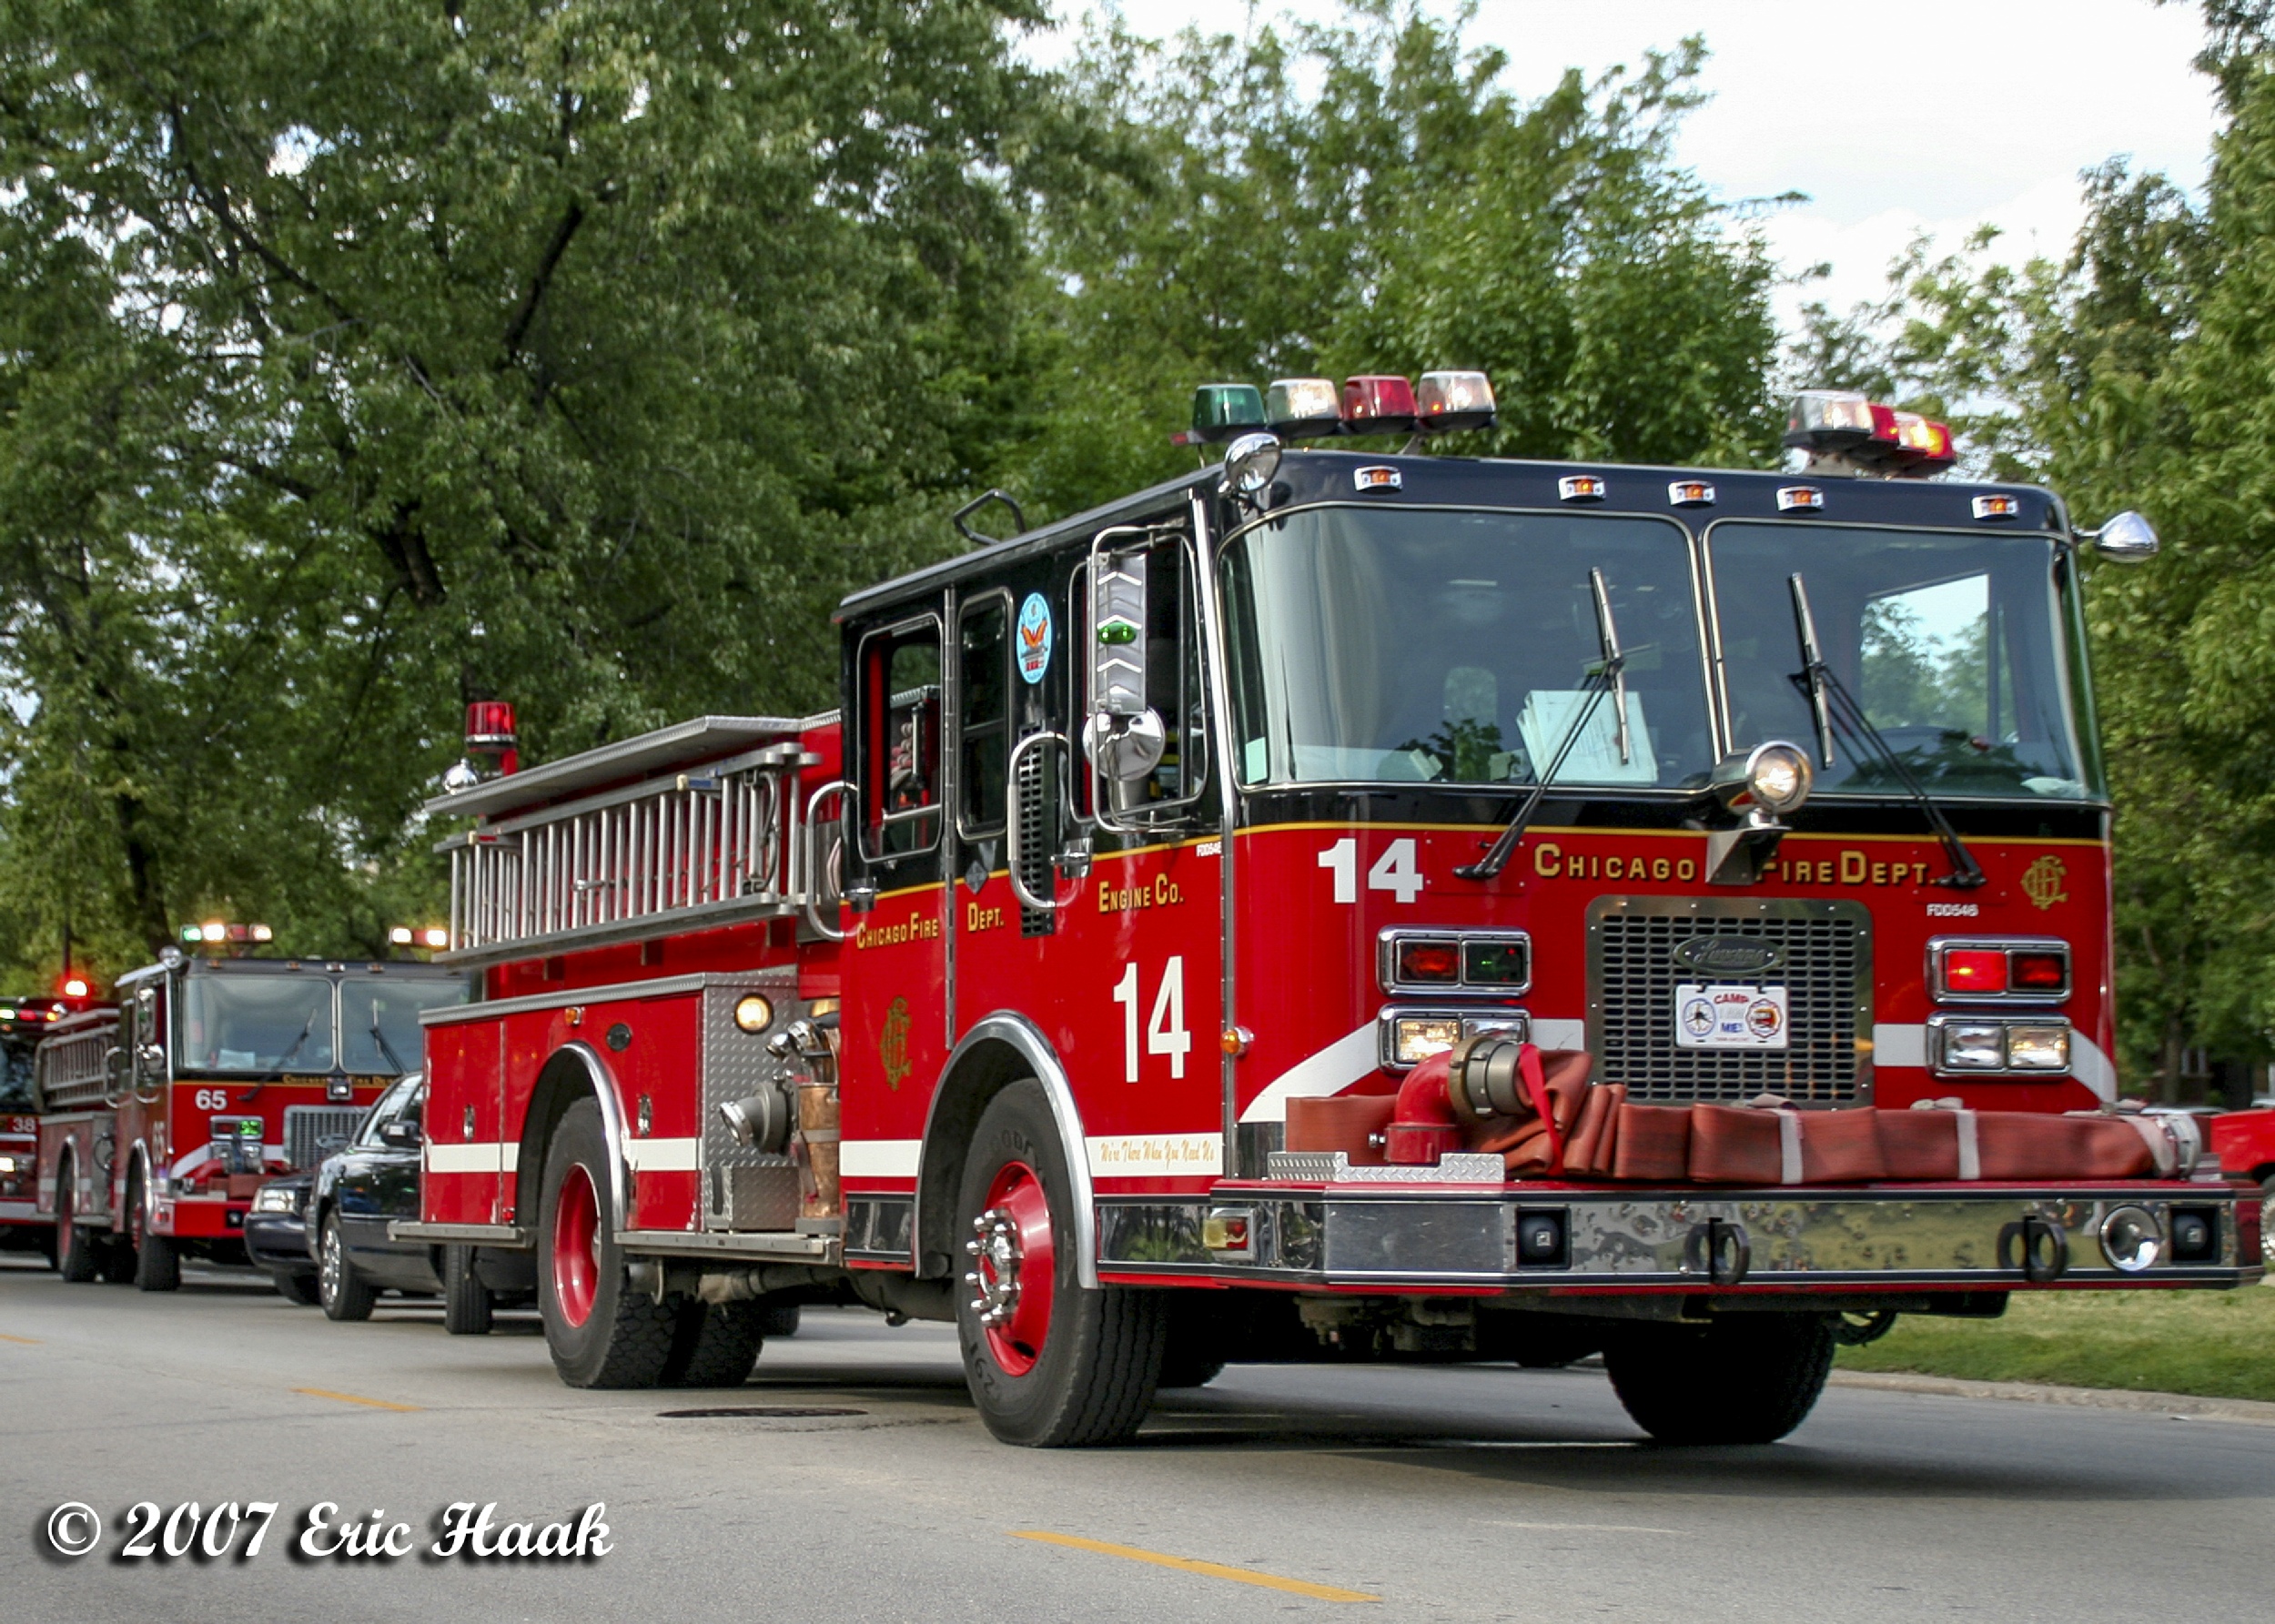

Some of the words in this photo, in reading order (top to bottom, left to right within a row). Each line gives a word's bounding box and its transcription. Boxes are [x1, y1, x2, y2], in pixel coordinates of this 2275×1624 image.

[1318, 838, 1423, 903] 14
[1534, 842, 1695, 881] CHICAGO
[1840, 850, 1937, 884] DEPT.
[1099, 881, 1151, 913] ENGINE
[1156, 872, 1184, 905] CO.
[856, 921, 907, 950] CHICAGO
[910, 912, 939, 941] FIRE
[967, 902, 1005, 933] DEPT.
[1113, 955, 1191, 1083] 14
[195, 1088, 228, 1110] 65
[13, 1116, 35, 1133] 38
